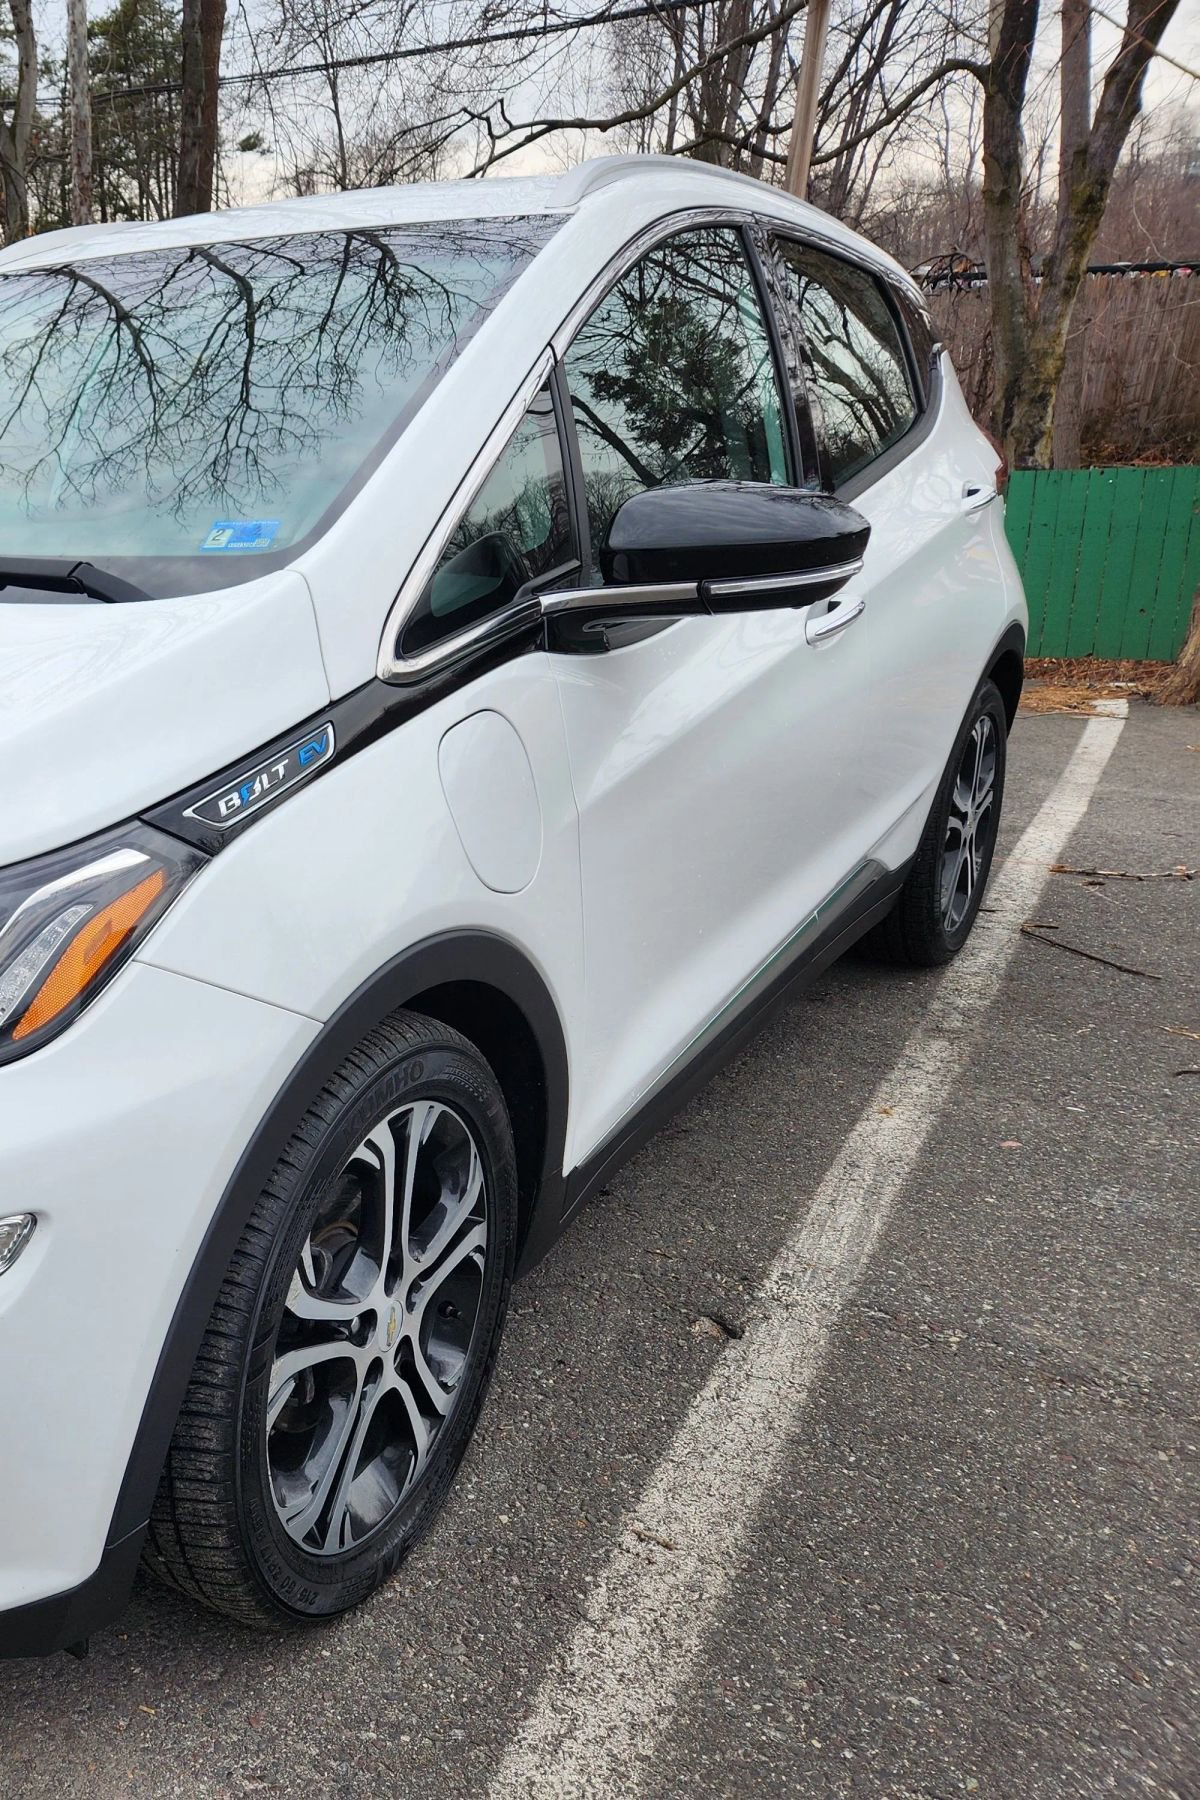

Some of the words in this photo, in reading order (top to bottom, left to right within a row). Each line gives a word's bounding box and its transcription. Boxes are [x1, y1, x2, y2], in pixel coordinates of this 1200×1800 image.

[218, 759, 289, 817] BOLT
[297, 734, 327, 767] EV
[343, 1059, 425, 1136] KUMHO
